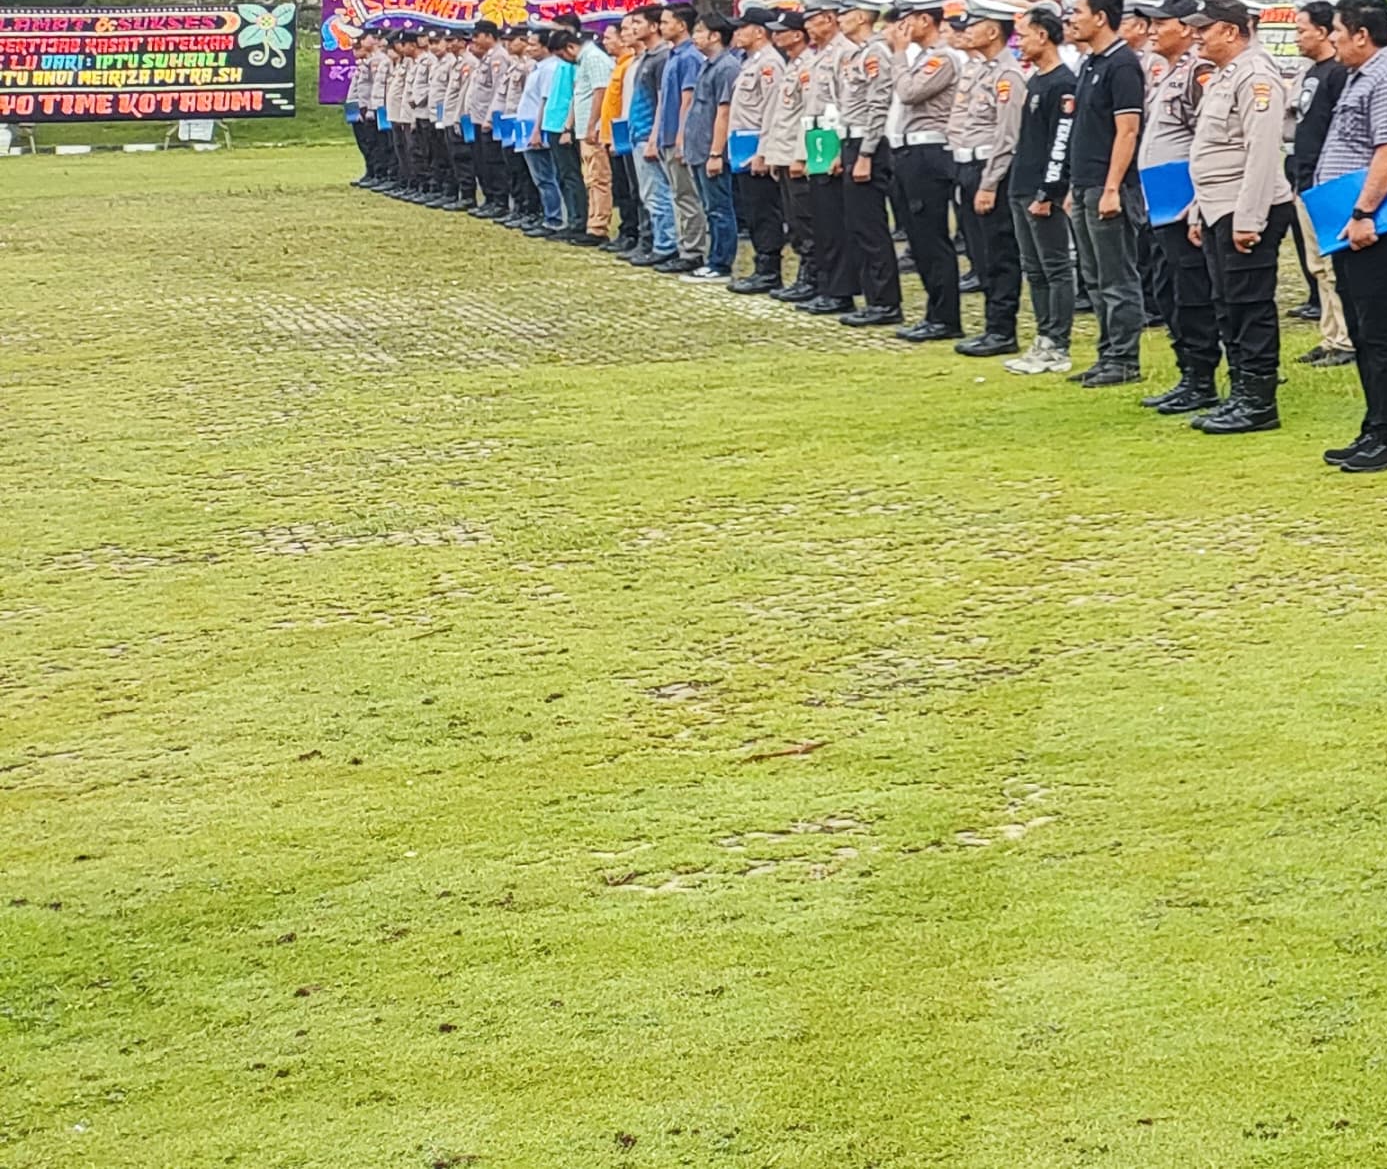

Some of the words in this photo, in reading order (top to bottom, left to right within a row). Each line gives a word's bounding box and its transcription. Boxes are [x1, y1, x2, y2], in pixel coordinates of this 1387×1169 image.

[0, 16, 91, 31] LAMAT
[85, 37, 143, 55] KASAT
[147, 35, 234, 53] INTELKAM
[95, 53, 140, 70] IPTU
[141, 52, 228, 68] SUHAILI
[38, 93, 114, 115] TIME
[118, 91, 264, 118] KOTABUMI
